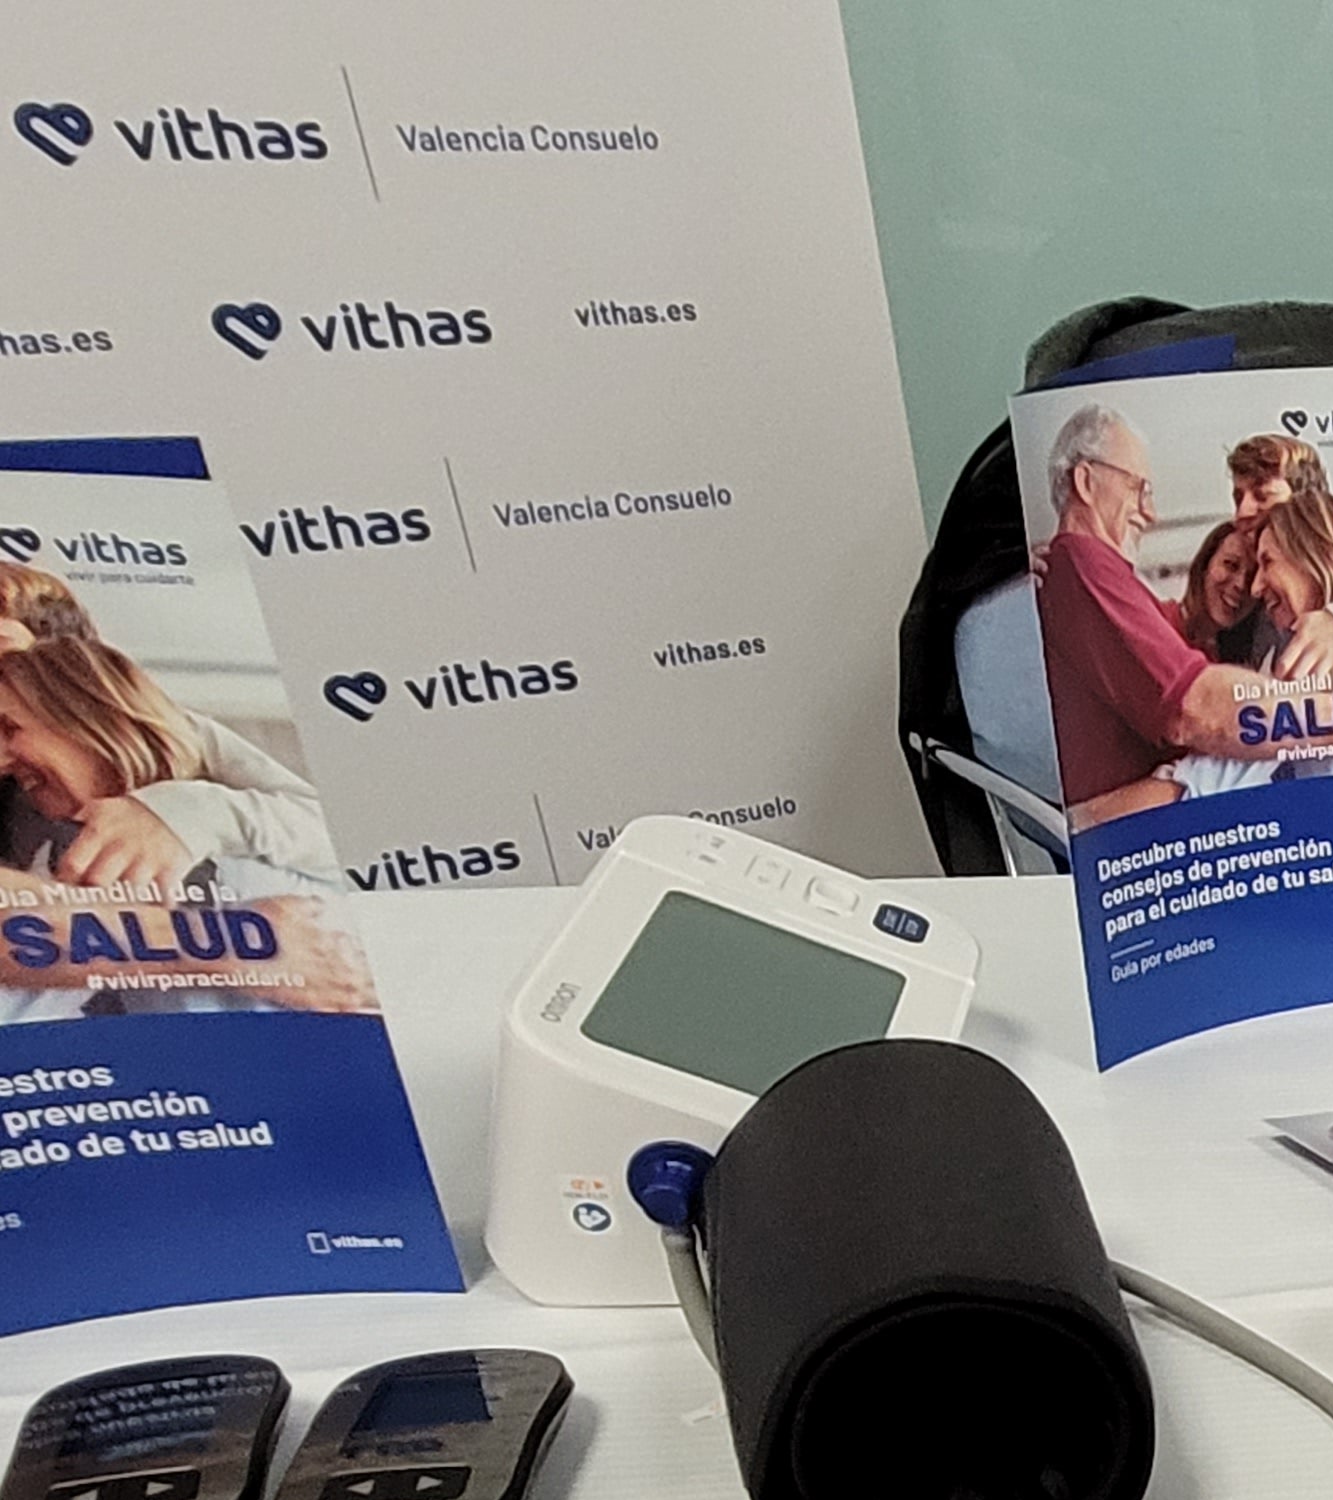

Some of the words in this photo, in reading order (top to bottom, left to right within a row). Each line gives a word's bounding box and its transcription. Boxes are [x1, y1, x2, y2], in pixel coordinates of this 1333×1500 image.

[114, 107, 328, 161] vithas
[398, 124, 525, 153] Valencia
[531, 124, 659, 152] Consuelo
[301, 302, 493, 352] vithas
[575, 299, 698, 329] vithas.es
[0, 330, 113, 356] has.es
[493, 496, 609, 528] Valencia
[614, 485, 732, 518] Consuelo
[54, 532, 187, 566] vithas
[240, 505, 431, 558] vithas
[654, 635, 766, 669] vithas.es
[405, 658, 578, 711] vithas
[1265, 673, 1333, 698] Mundial
[346, 840, 521, 892] vithas
[1098, 838, 1186, 882] Descubre
[1189, 821, 1281, 855] nuestros
[43, 880, 162, 905] Mundial
[171, 880, 204, 902] de
[210, 879, 238, 902] la
[1102, 868, 1184, 909] consejos
[1188, 860, 1213, 882] de
[1217, 839, 1333, 879] prevención
[1105, 910, 1146, 942] para
[1149, 901, 1167, 921] el
[1169, 880, 1248, 914] cuidado
[1252, 872, 1279, 895] de
[1282, 868, 1305, 889] tu
[2, 909, 278, 968] SALUD
[1141, 953, 1162, 975] por
[1165, 937, 1215, 963] edades
[87, 969, 305, 992] #vivirparacuidarte
[0, 1065, 115, 1097] estros
[2, 1091, 210, 1138] prevención
[77, 1132, 126, 1158] de
[130, 1129, 172, 1153] tu
[177, 1121, 275, 1150] salud
